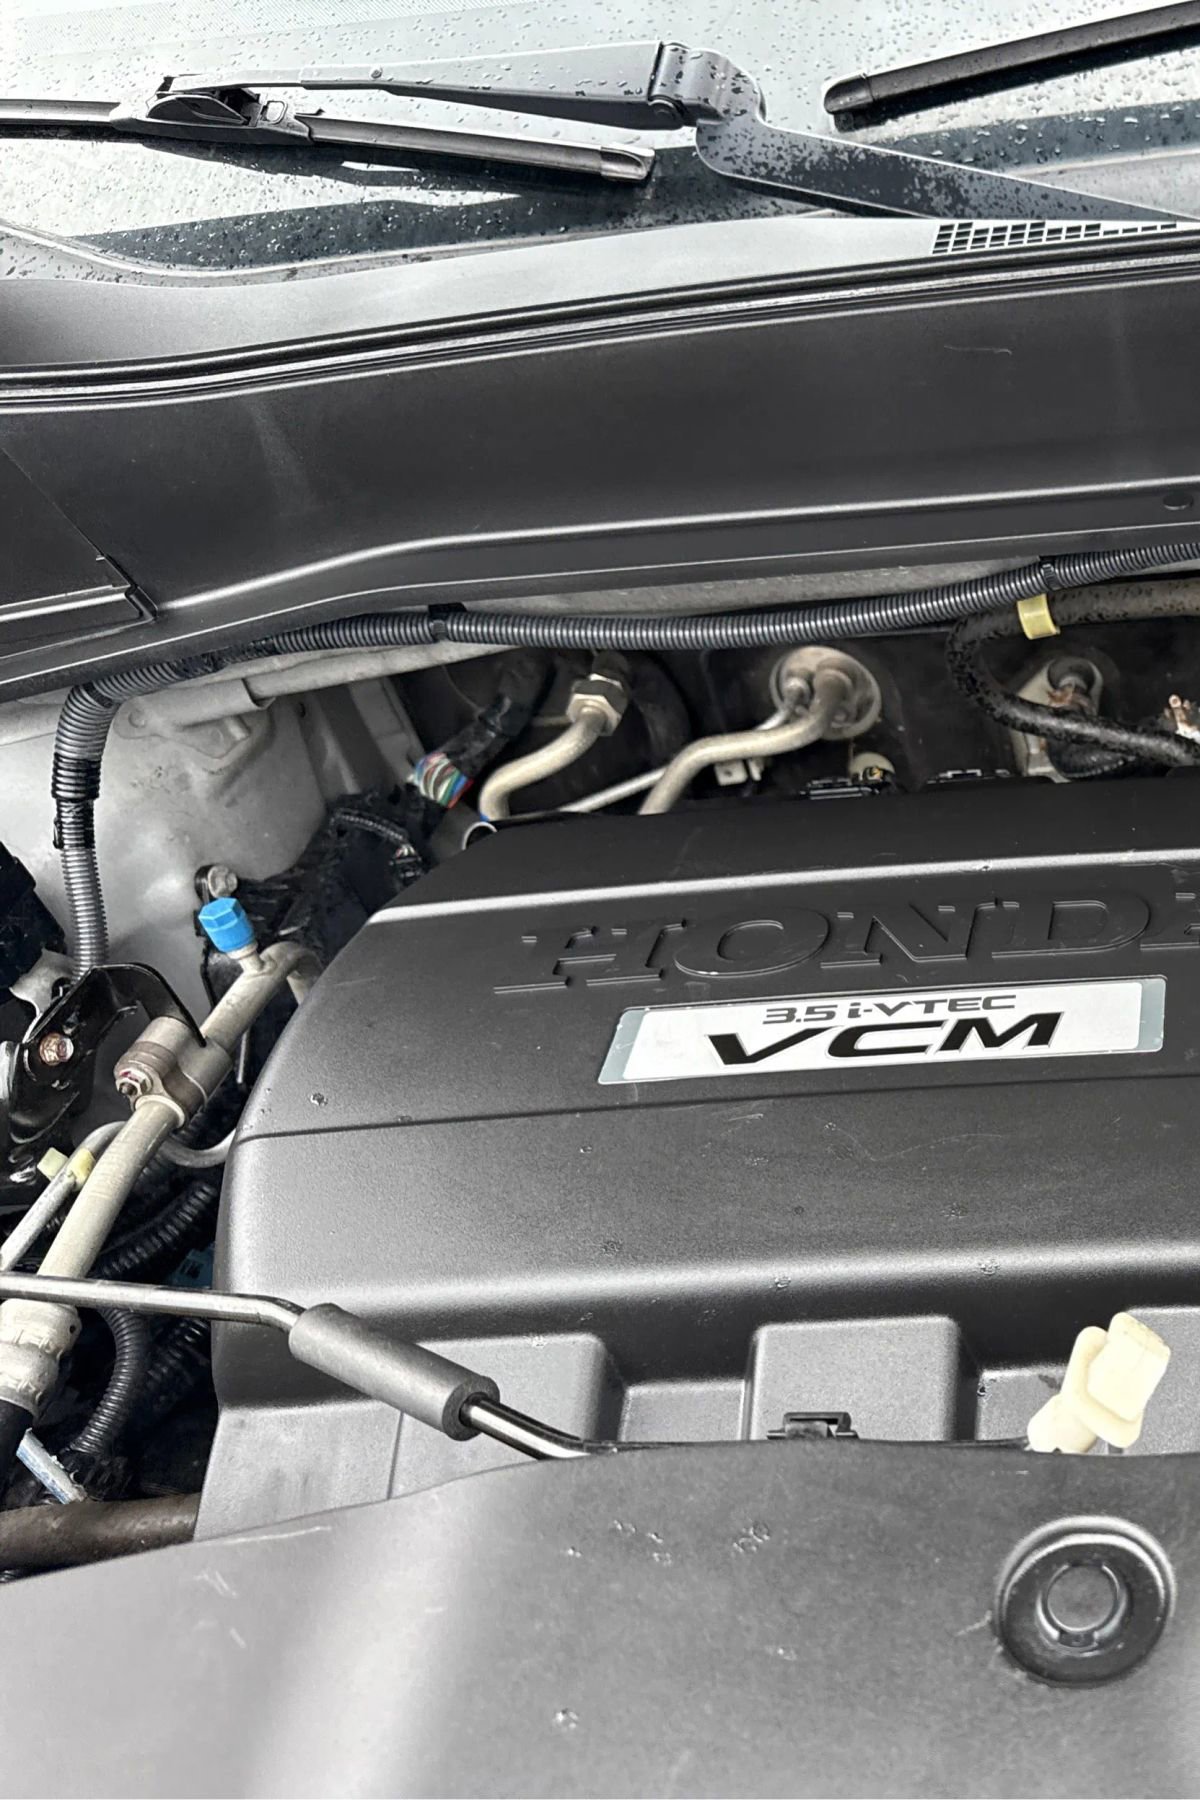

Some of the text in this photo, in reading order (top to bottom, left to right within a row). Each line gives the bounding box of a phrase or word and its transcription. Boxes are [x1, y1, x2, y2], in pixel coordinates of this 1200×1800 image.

[763, 995, 1017, 1025] 3.5 i-VTEC
[708, 1012, 1065, 1065] VCM
